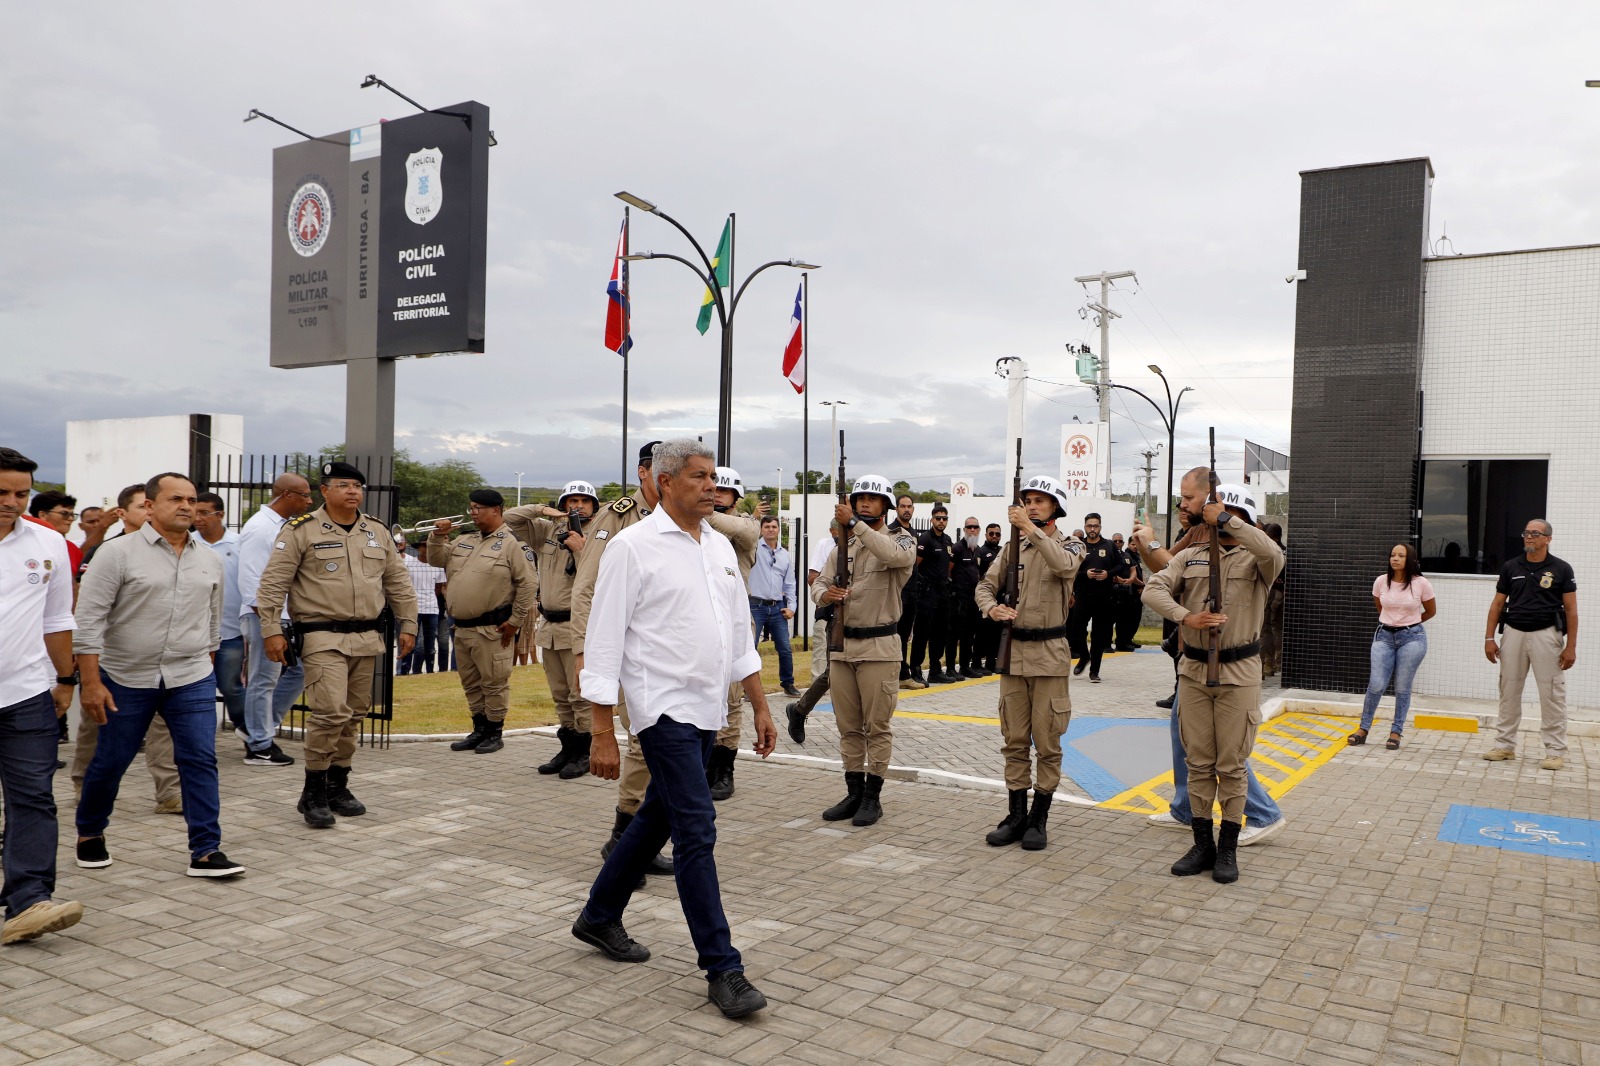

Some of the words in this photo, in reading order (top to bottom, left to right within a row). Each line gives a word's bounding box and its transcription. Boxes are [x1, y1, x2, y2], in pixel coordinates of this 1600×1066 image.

[361, 170, 370, 194] BA
[414, 206, 431, 214] CIVIL
[359, 210, 368, 299] BIRITINGA
[399, 244, 445, 263] POLÍCIA
[289, 269, 328, 286] POLÍCIA
[405, 264, 437, 280] CIVIL
[288, 287, 328, 303] MILITAR
[397, 292, 446, 308] DELEGACIA
[304, 316, 317, 327] 190
[393, 306, 450, 321] TERRITORIAL
[1067, 479, 1088, 491] 192
